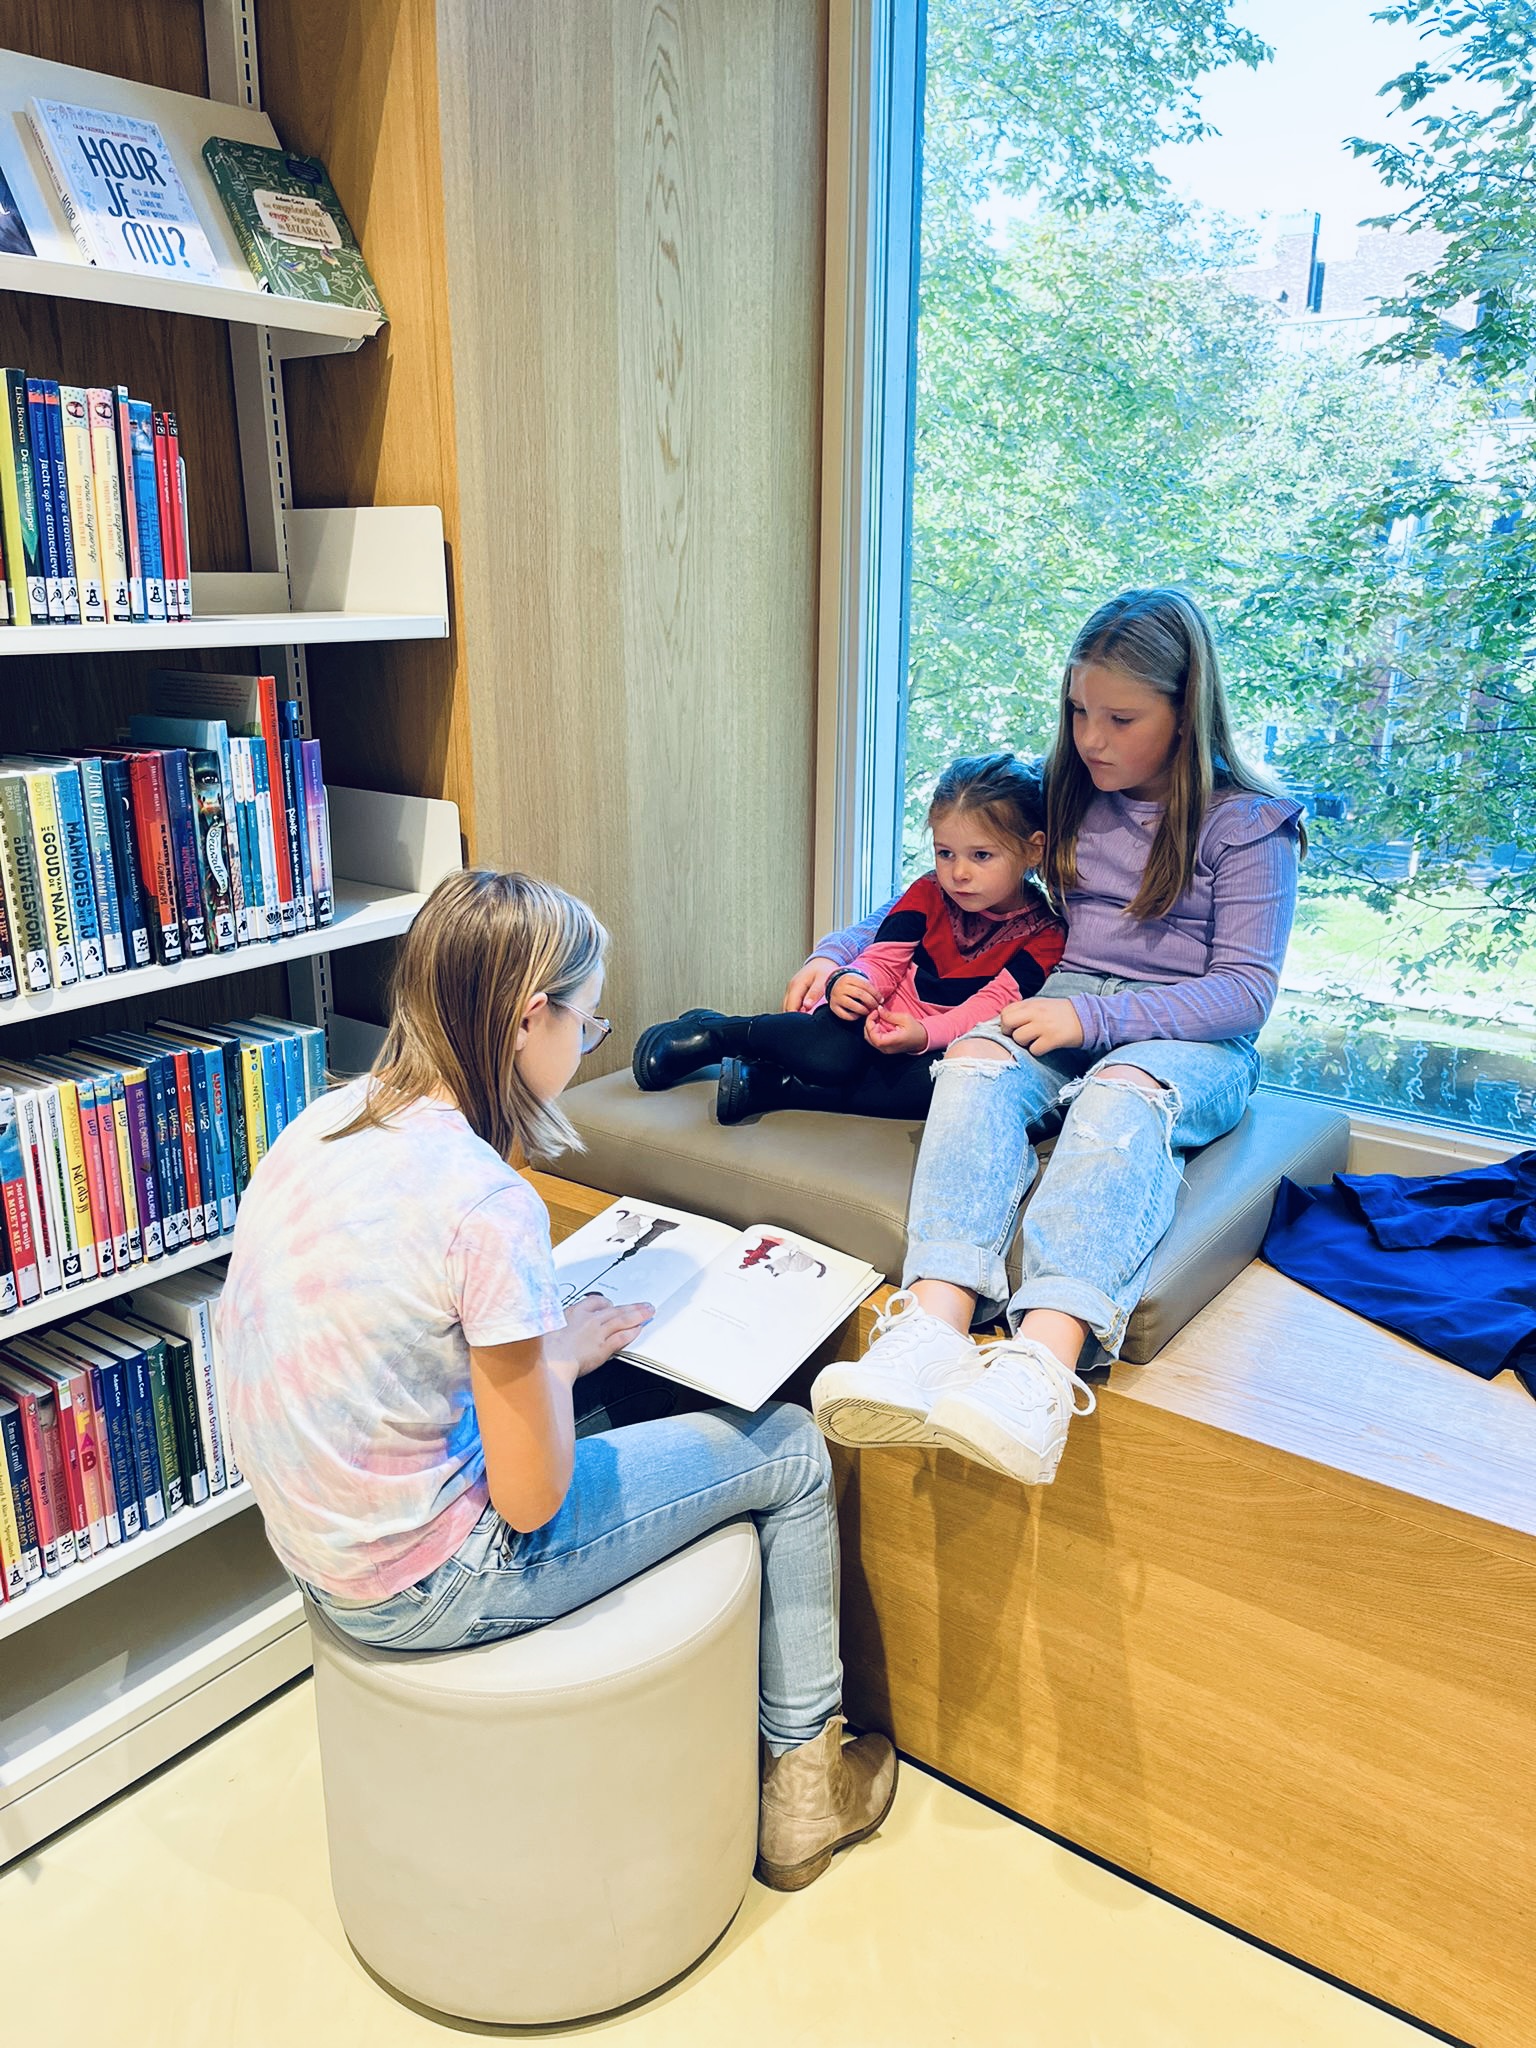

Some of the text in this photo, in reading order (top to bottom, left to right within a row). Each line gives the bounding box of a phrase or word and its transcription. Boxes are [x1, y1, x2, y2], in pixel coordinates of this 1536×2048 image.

[77, 135, 167, 187] HOOR
[104, 178, 136, 218] JE
[121, 221, 191, 268] MIJ?
[15, 387, 28, 443] Lisa Boersen
[35, 411, 45, 429] Jonas
[38, 458, 52, 487] Jacht
[55, 460, 67, 489] Jacht
[84, 475, 93, 501] Emma
[112, 475, 120, 501] Emma
[20, 449, 36, 532] De stemmenslurper
[41, 490, 51, 500] op
[44, 501, 53, 512] de
[58, 490, 67, 501] op
[60, 502, 69, 513] de
[136, 501, 151, 540] ZOETE
[5, 786, 15, 810] BOYER
[87, 767, 107, 837] JOHN BOYNE
[43, 833, 60, 877] GOUD
[66, 821, 93, 908] MAMMOETS
[126, 831, 134, 854] oorlog
[131, 873, 140, 902] eindelijk
[161, 824, 175, 907] DE LAATSTE HELDEN OP
[208, 829, 227, 890] Seawalkers
[48, 879, 55, 888] DE
[87, 909, 94, 917] IN
[81, 924, 96, 939] IJ
[135, 1088, 146, 1103] HET
[213, 1073, 224, 1115] LUCAS
[87, 1119, 97, 1137] Lizzy
[102, 1114, 112, 1132] Lizzy
[118, 1110, 128, 1127] Lizzy
[157, 1112, 168, 1145] Lifelines
[168, 1107, 180, 1140] Lifelines
[71, 1164, 85, 1184] Net
[77, 1186, 88, 1203] als
[6, 1184, 23, 1253] IK MOET MEE
[15, 1182, 32, 1250] Jorien de Bruijn
[200, 1328, 208, 1348] Cherry
[182, 1355, 192, 1369] THE
[113, 1374, 121, 1388] Adam
[136, 1365, 146, 1399] Adam Cece
[184, 1371, 193, 1395] SECRET
[204, 1365, 221, 1464] De schat van Gruizelkaak
[7, 1421, 22, 1472] Emma Carroll
[162, 1436, 174, 1480] BIZARRIA
[117, 1459, 131, 1503] BIZARRIA
[140, 1450, 154, 1493] BIZARRIA
[11, 1484, 21, 1502] VAN
[16, 1513, 28, 1546] FARAO
[20, 1478, 37, 1544] HET MYSTERIE
